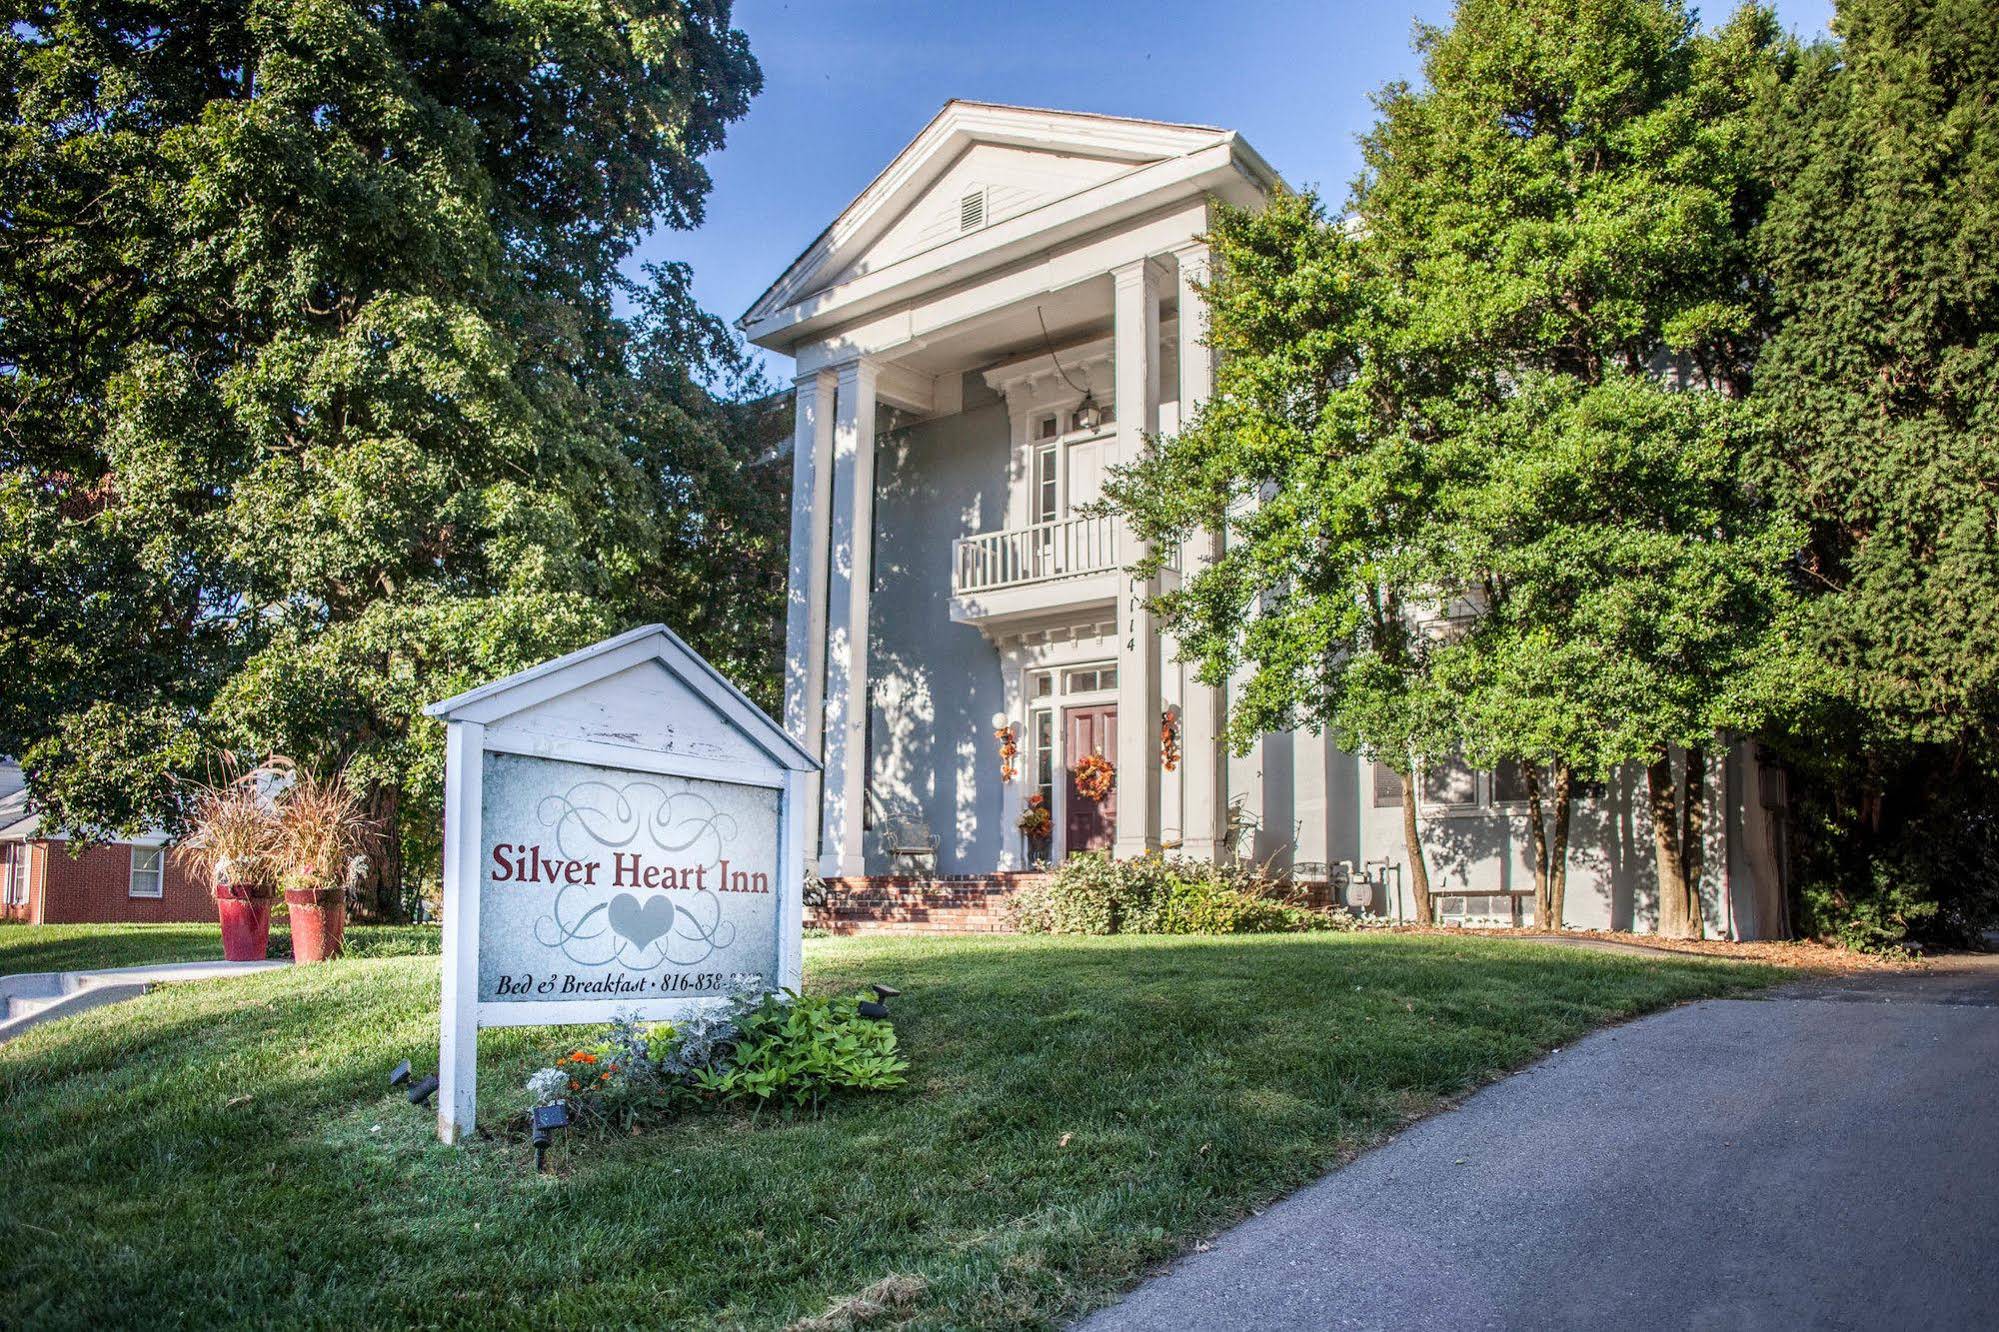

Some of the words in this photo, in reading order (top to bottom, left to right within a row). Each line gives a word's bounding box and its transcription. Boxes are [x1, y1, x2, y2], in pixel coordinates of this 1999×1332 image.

[491, 843, 601, 885] Silver
[612, 852, 707, 890] Heart
[719, 859, 769, 894] Inn
[495, 973, 533, 995] Bed
[537, 974, 558, 994] &
[560, 972, 647, 995] Breakfast
[660, 972, 763, 992] 816-838-
